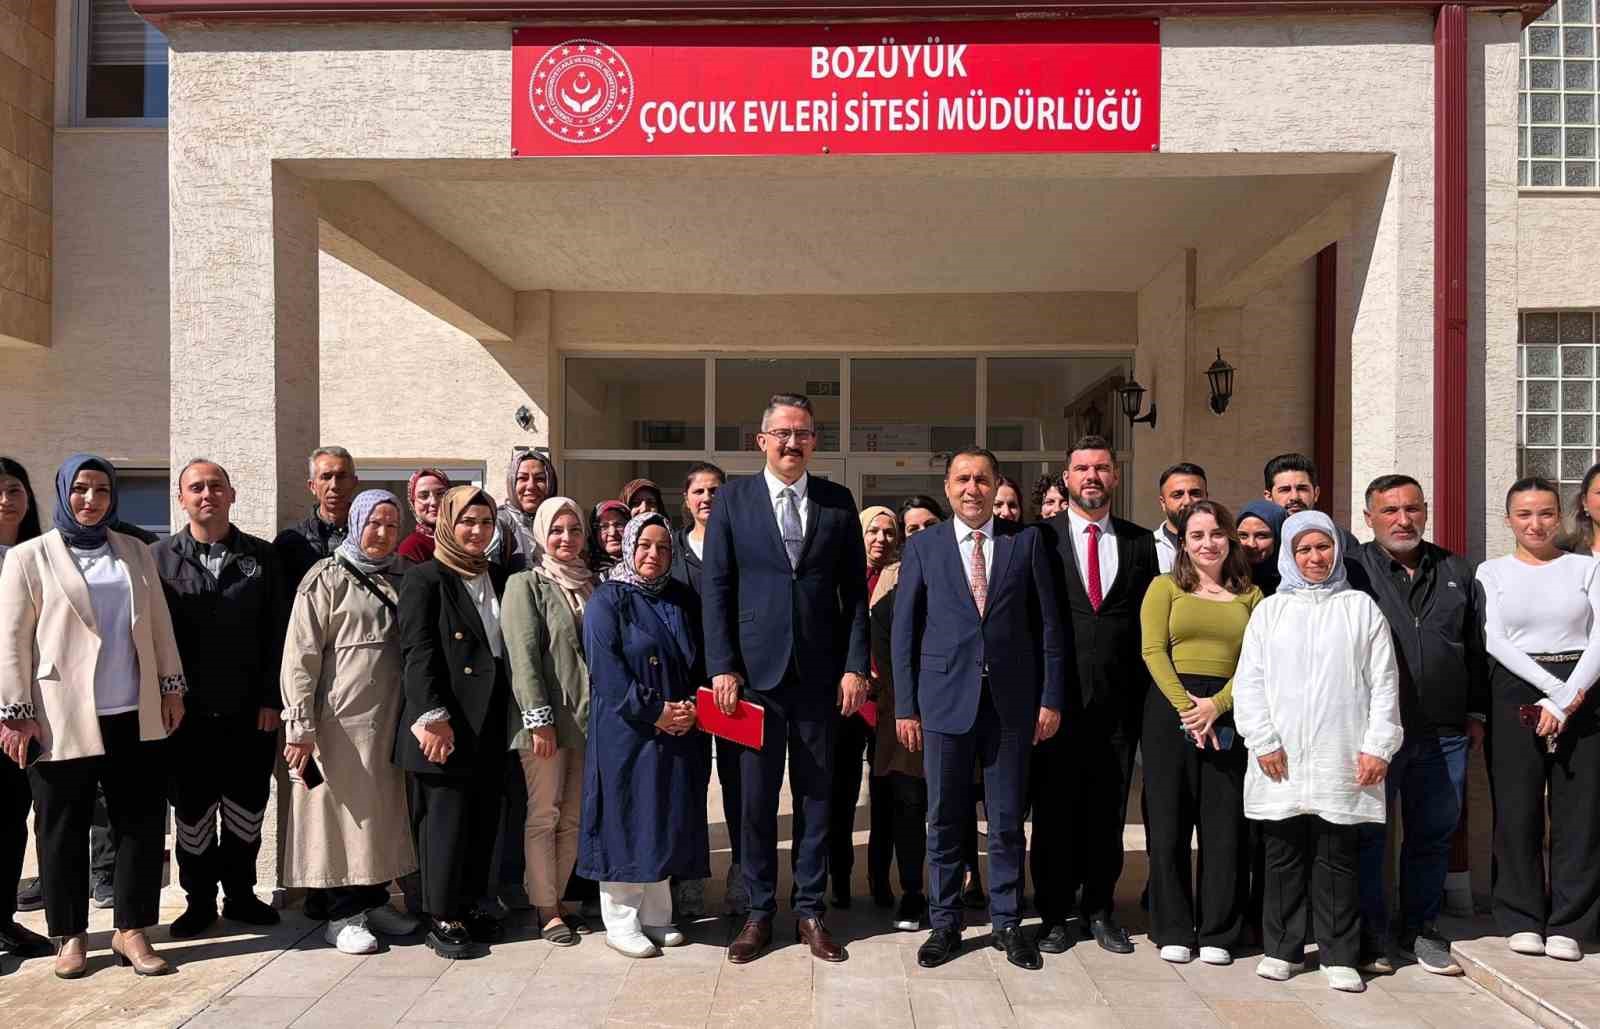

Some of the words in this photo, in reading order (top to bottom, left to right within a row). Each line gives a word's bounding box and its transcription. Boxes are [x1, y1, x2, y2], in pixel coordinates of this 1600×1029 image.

[810, 37, 968, 79] BOZÜYÜK
[639, 101, 737, 143] ÇOCUK
[743, 91, 838, 134] EVLERİ
[844, 90, 929, 133] SİTESİ
[937, 88, 1143, 131] MÜDÜRLÜĞÜ
